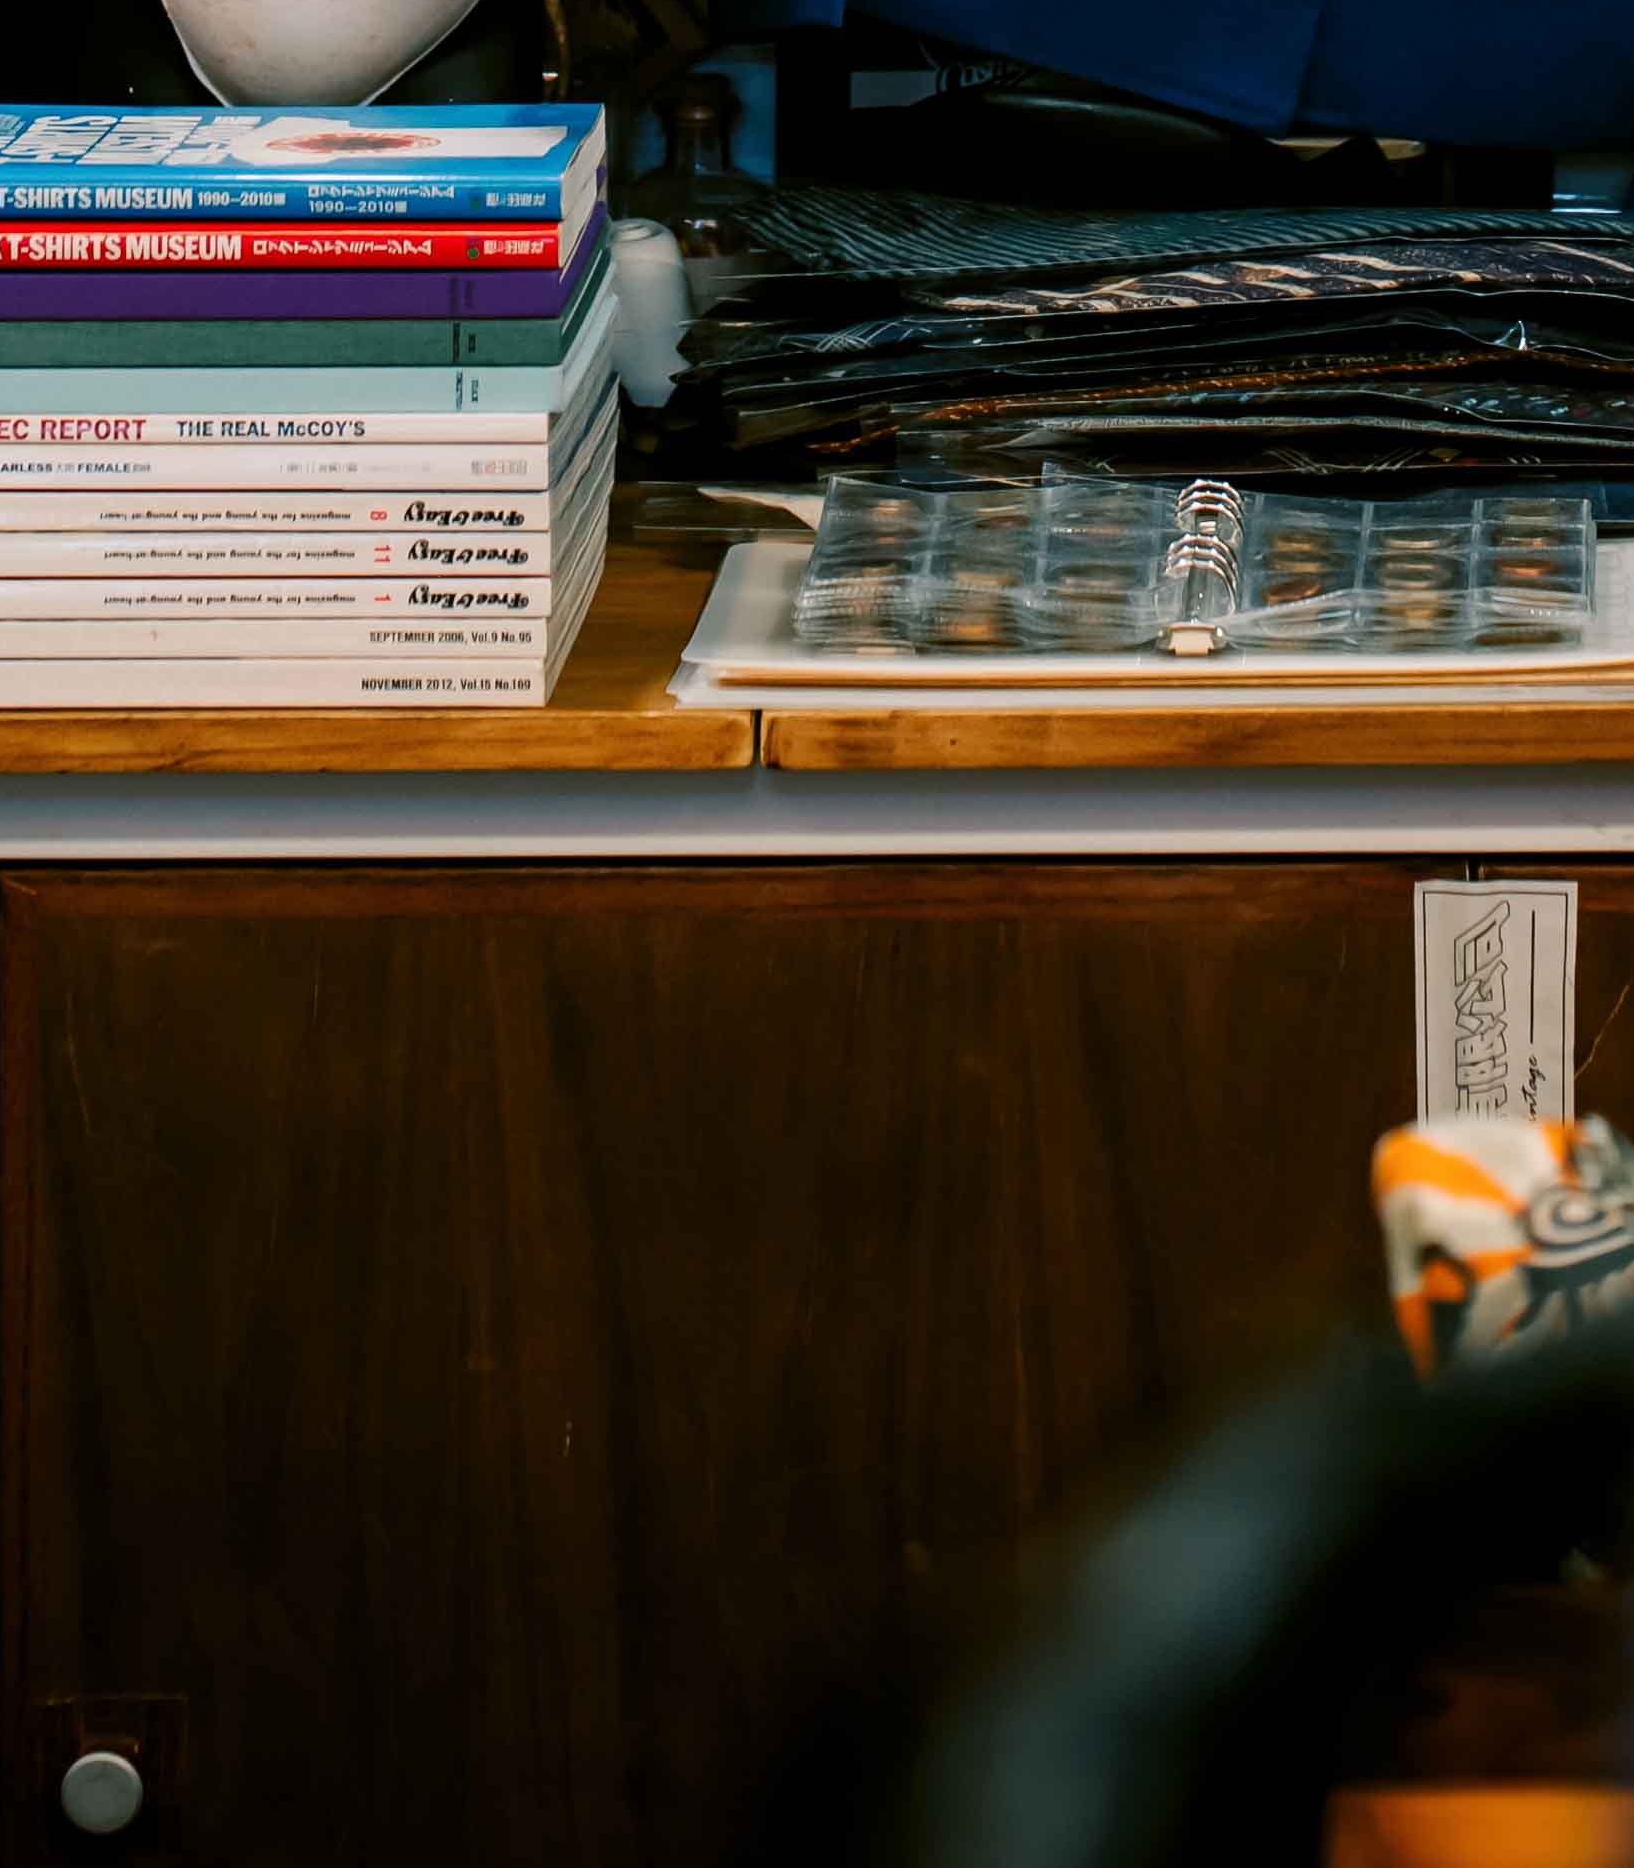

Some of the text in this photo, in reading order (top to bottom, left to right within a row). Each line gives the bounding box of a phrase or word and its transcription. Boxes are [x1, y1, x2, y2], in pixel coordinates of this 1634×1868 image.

[95, 187, 193, 210] MUSEUM
[7, 233, 121, 261] T-SHIRTS
[125, 234, 242, 261] MUSEUM
[40, 419, 147, 441] REPORT
[177, 420, 214, 438] THE
[222, 421, 271, 438] REAL
[277, 420, 366, 438] McCOY'S
[77, 462, 129, 474] FEMALE
[369, 631, 435, 644] SEPTEMBER
[361, 678, 423, 691] NOVEMBER
